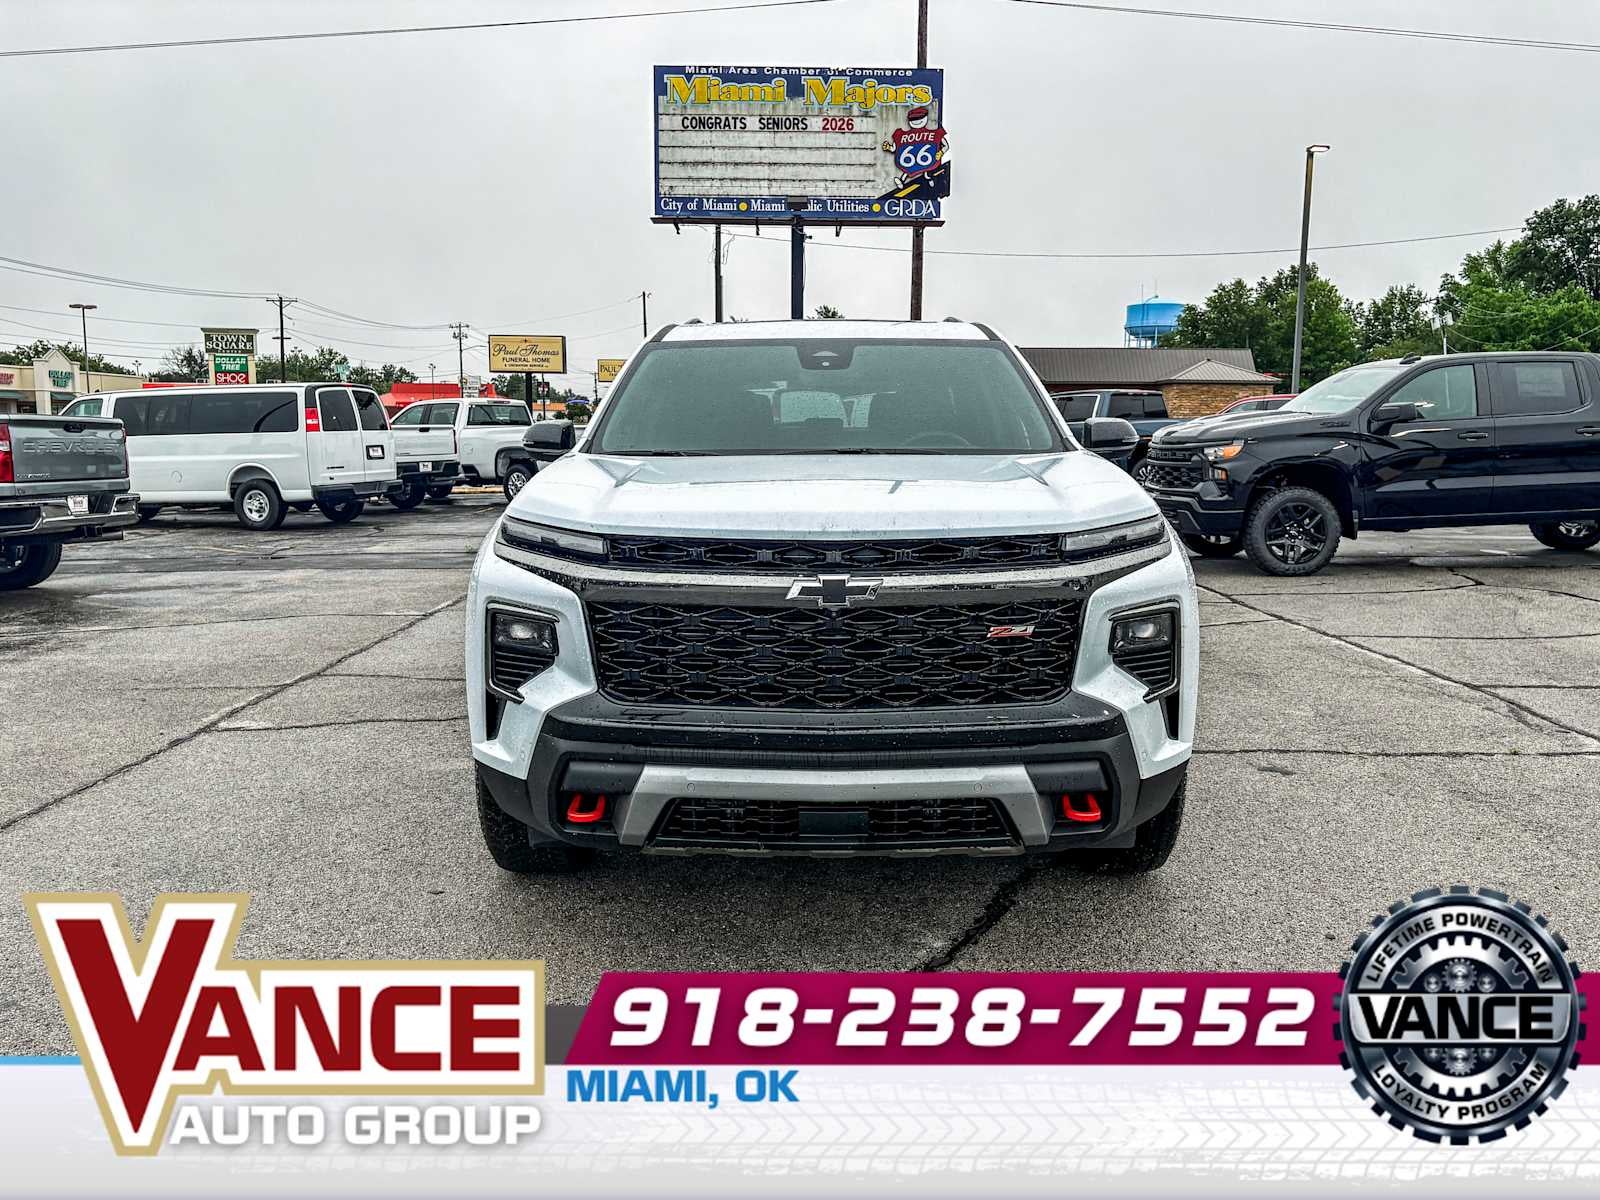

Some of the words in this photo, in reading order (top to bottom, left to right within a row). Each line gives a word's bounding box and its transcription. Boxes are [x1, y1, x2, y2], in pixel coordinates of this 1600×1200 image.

[685, 66, 723, 74] Miami
[728, 66, 758, 75] Area
[763, 66, 820, 76] Chamber
[845, 68, 913, 77] Commerce
[665, 76, 786, 104] Miami
[802, 77, 932, 110] Majors
[681, 116, 747, 130] CONGRATS
[758, 117, 808, 131] SENIORS
[821, 117, 855, 131] 2026
[900, 132, 936, 144] ROUTE
[899, 144, 933, 168] 66
[660, 198, 683, 214] City
[686, 198, 699, 211] of
[702, 199, 738, 211] Miami
[750, 199, 785, 212] Miami
[827, 199, 870, 213] Utilities
[884, 198, 937, 217] GRDA
[210, 334, 247, 342] TOWN
[206, 341, 253, 350] SQUARE
[492, 343, 520, 357] Paul
[519, 344, 560, 357] Thomas
[220, 363, 241, 371] TREE
